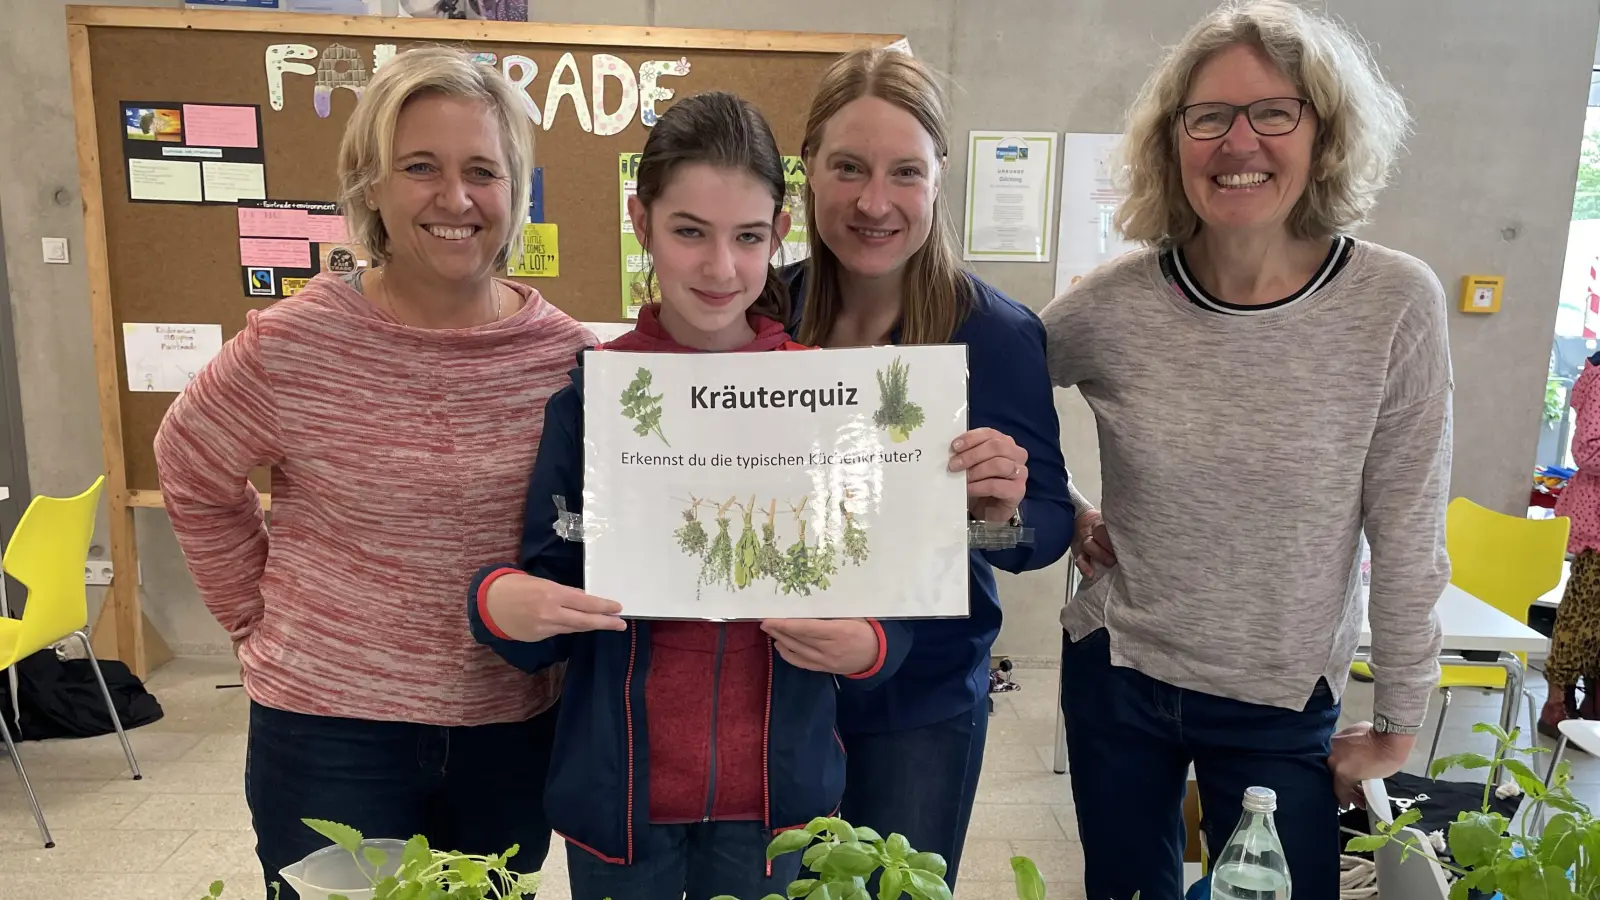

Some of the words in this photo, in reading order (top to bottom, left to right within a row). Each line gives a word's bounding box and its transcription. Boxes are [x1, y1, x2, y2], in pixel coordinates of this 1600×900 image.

[265, 43, 692, 136] FARADE
[692, 382, 858, 412] Kräuterquiz
[622, 452, 683, 465] Erkennst
[689, 454, 705, 466] du
[711, 454, 732, 466] die
[737, 453, 803, 469] typischen
